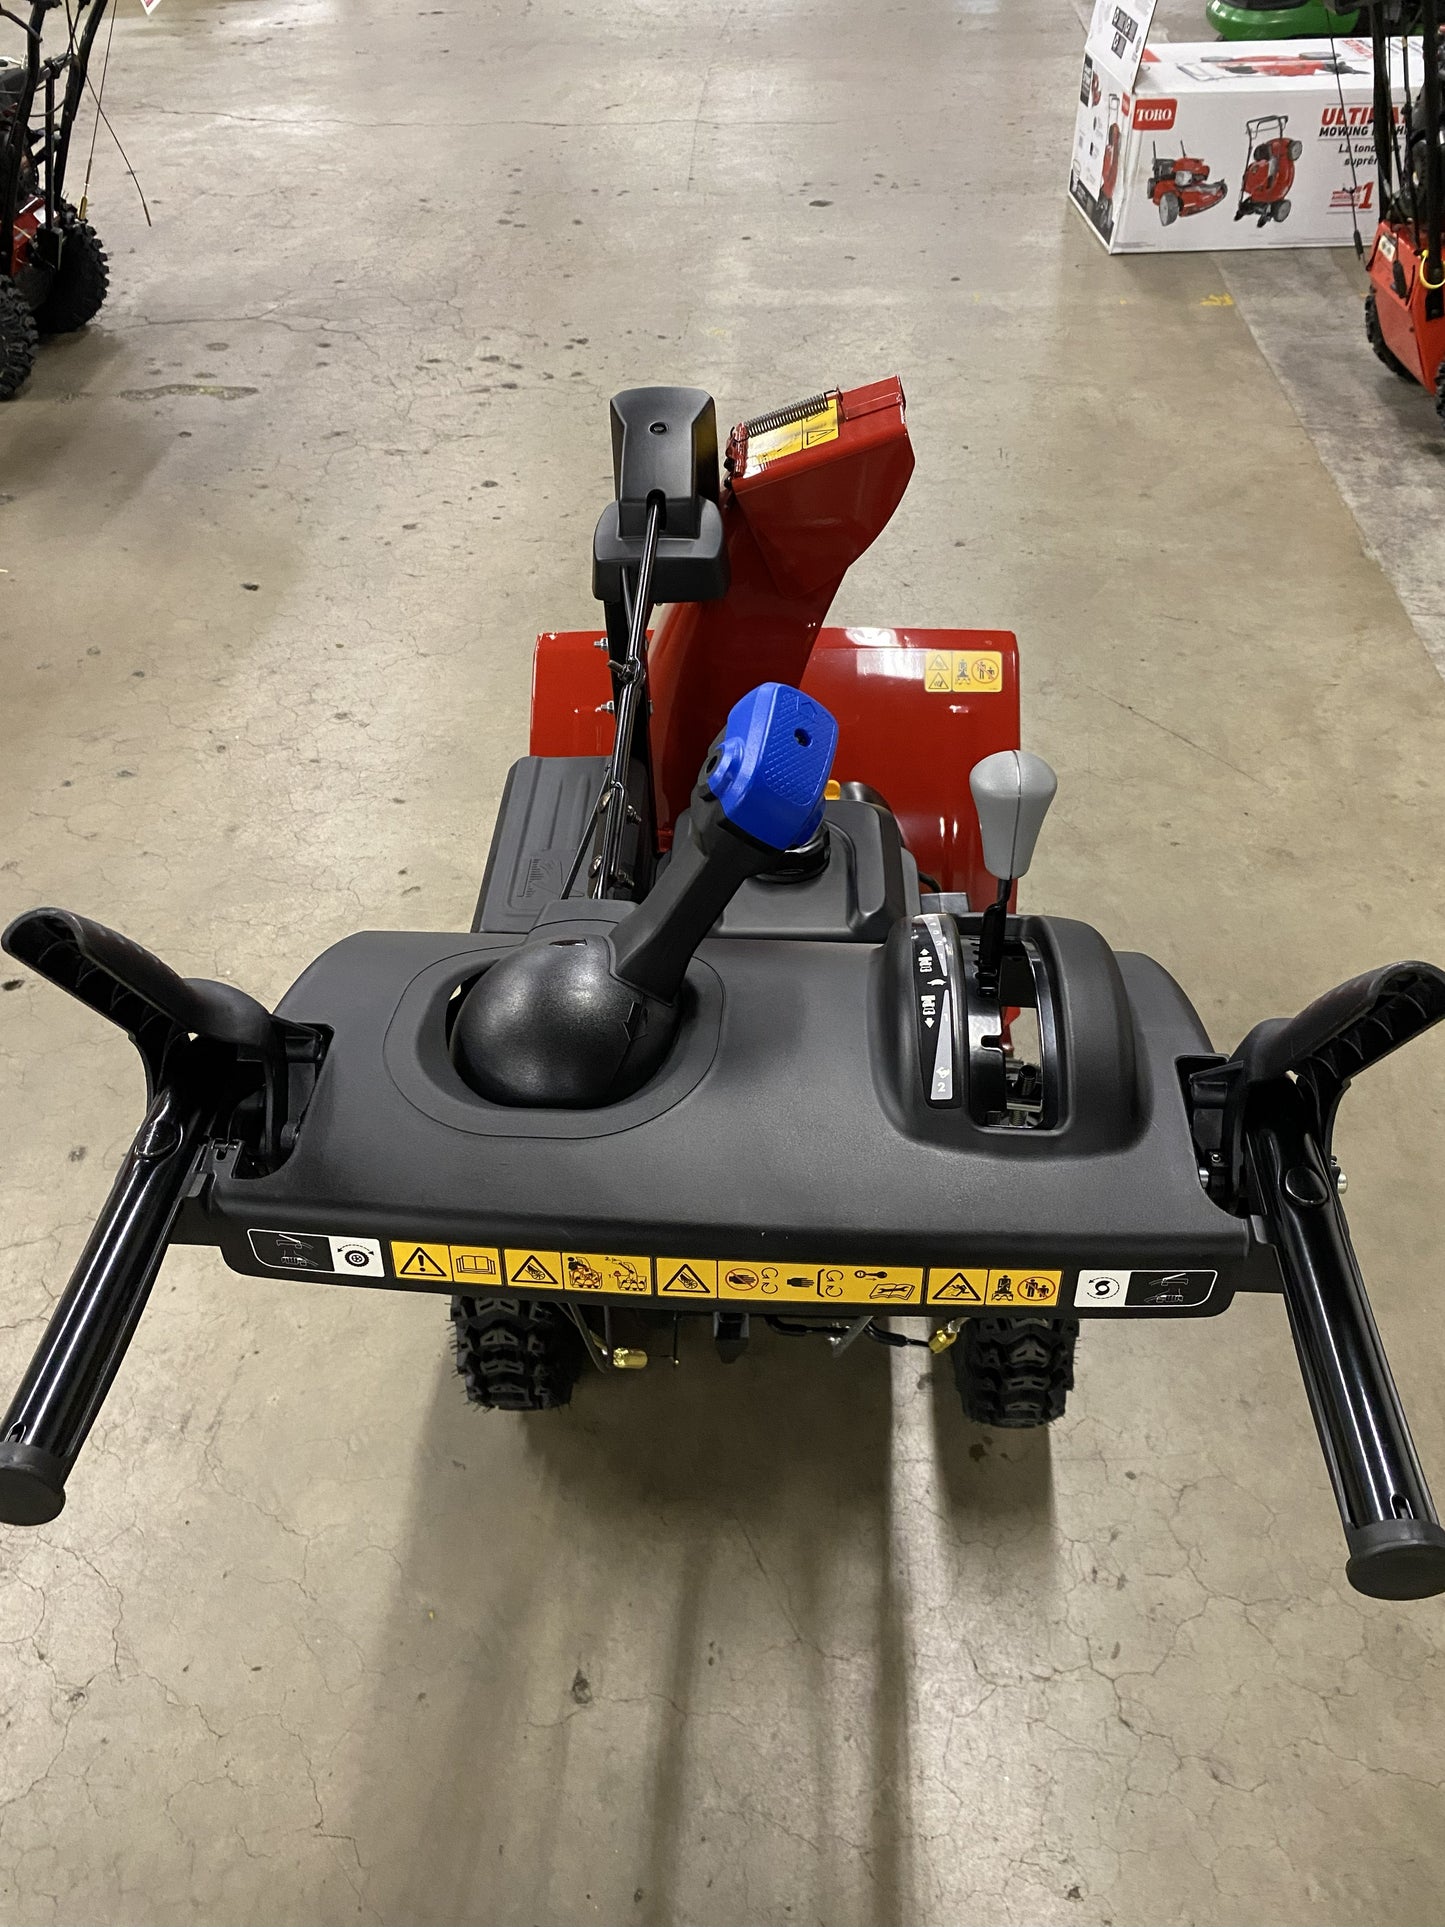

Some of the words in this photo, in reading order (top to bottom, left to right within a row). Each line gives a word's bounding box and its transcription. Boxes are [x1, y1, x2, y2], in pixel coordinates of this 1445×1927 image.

[1136, 108, 1173, 121] TORO
[1319, 126, 1368, 137] MOWING
[943, 1012, 949, 1022] 1
[937, 1081, 946, 1093] 2
